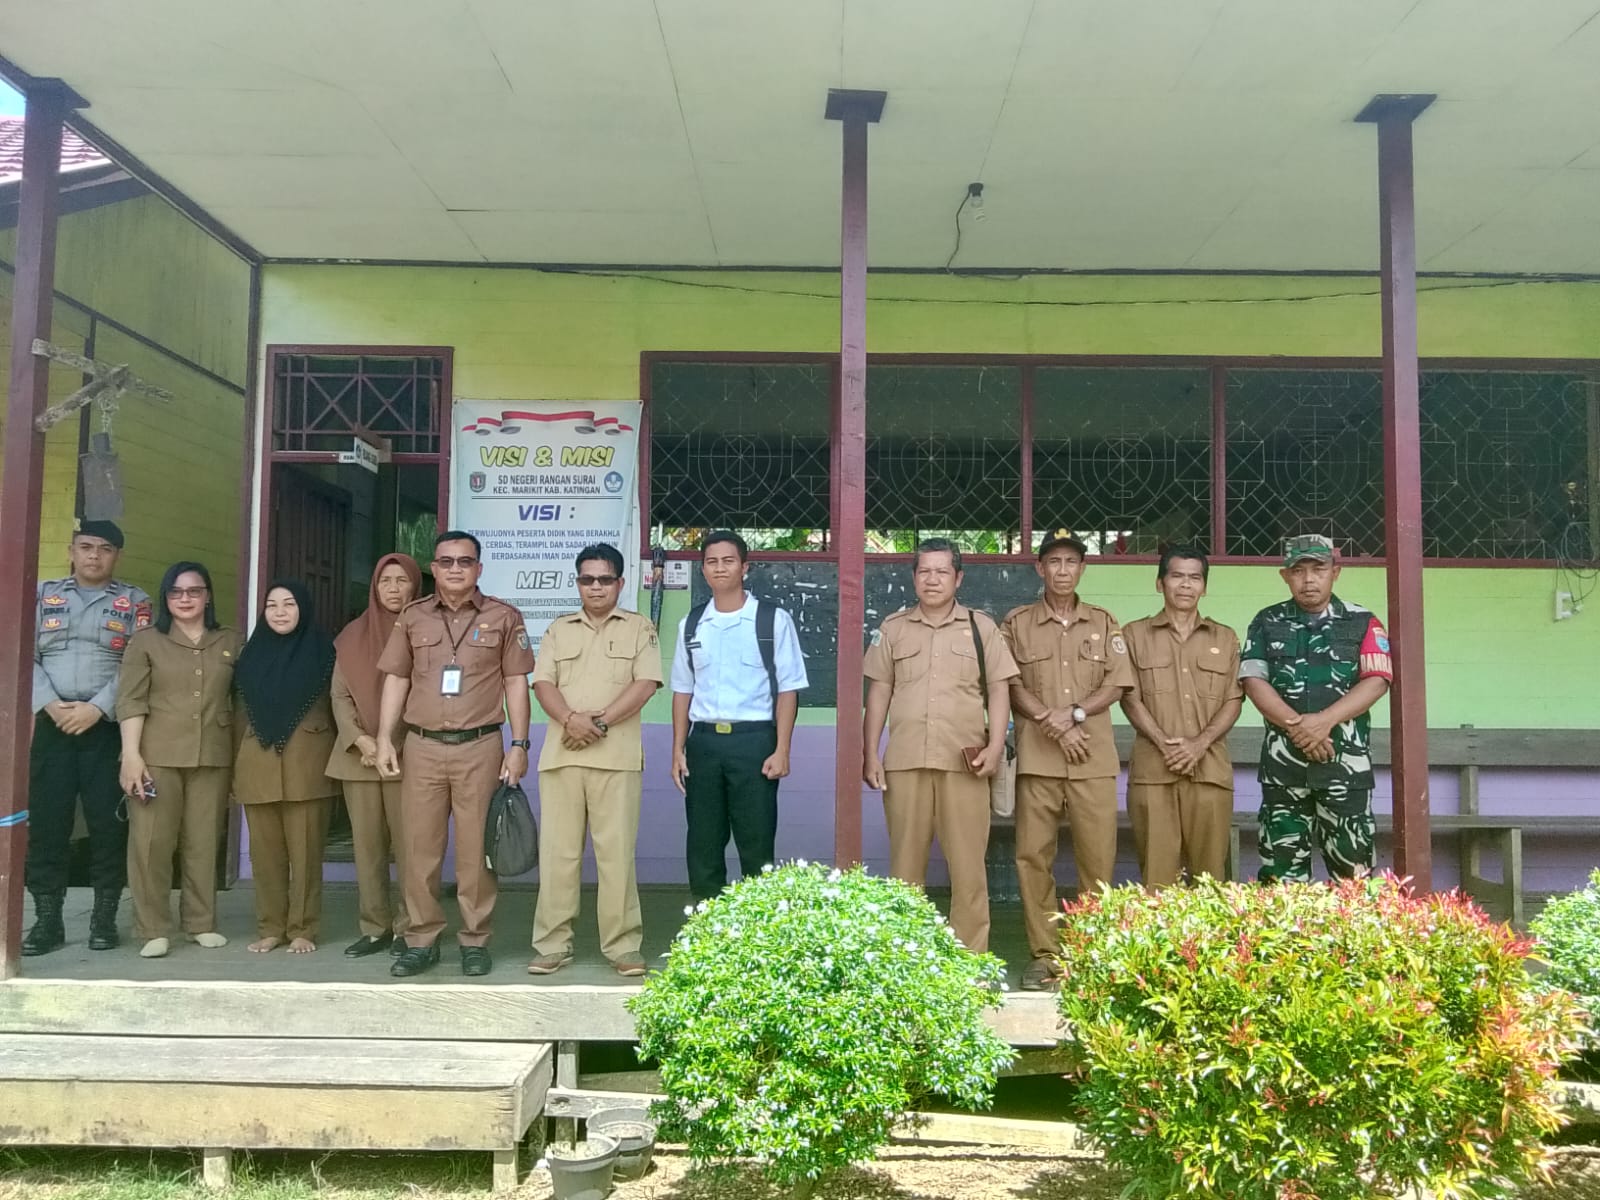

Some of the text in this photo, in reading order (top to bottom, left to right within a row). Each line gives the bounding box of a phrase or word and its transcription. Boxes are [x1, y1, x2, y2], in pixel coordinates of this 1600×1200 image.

[480, 445, 615, 468] VISI & MISI
[498, 474, 596, 485] SD NEGERI RANGAN SURAI
[493, 486, 600, 494] KEC. MARIKIT KAB. KATINGAN
[518, 504, 561, 521] VISI
[515, 541, 548, 549] TERAMPIL
[549, 541, 562, 549] DAN
[564, 541, 586, 549] SADAR
[491, 552, 540, 560] BERDASARKAN
[541, 552, 559, 560] IMAN
[561, 552, 575, 560] DAN
[516, 571, 563, 589] MISI
[103, 608, 133, 622] POLRI
